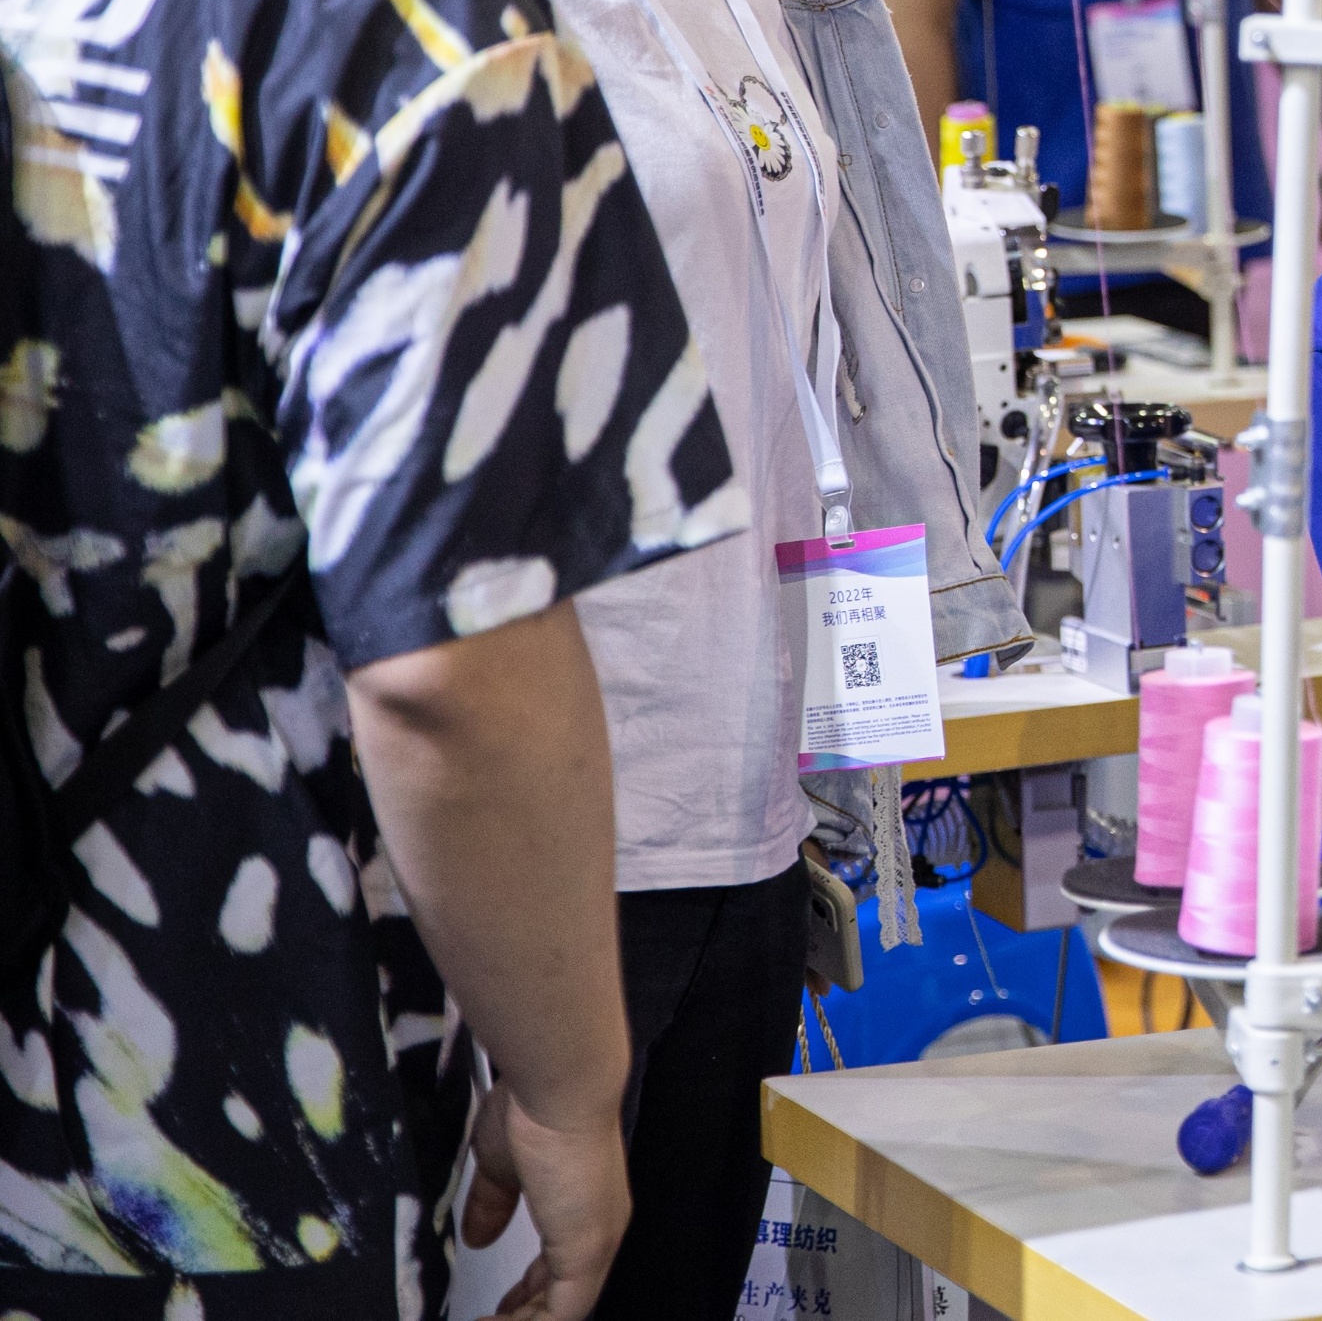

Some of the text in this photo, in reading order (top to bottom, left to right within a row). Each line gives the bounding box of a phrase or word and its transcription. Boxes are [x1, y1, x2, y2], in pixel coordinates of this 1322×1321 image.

[828, 587, 874, 604] 2022年
[822, 605, 887, 627] 我们再相聚
